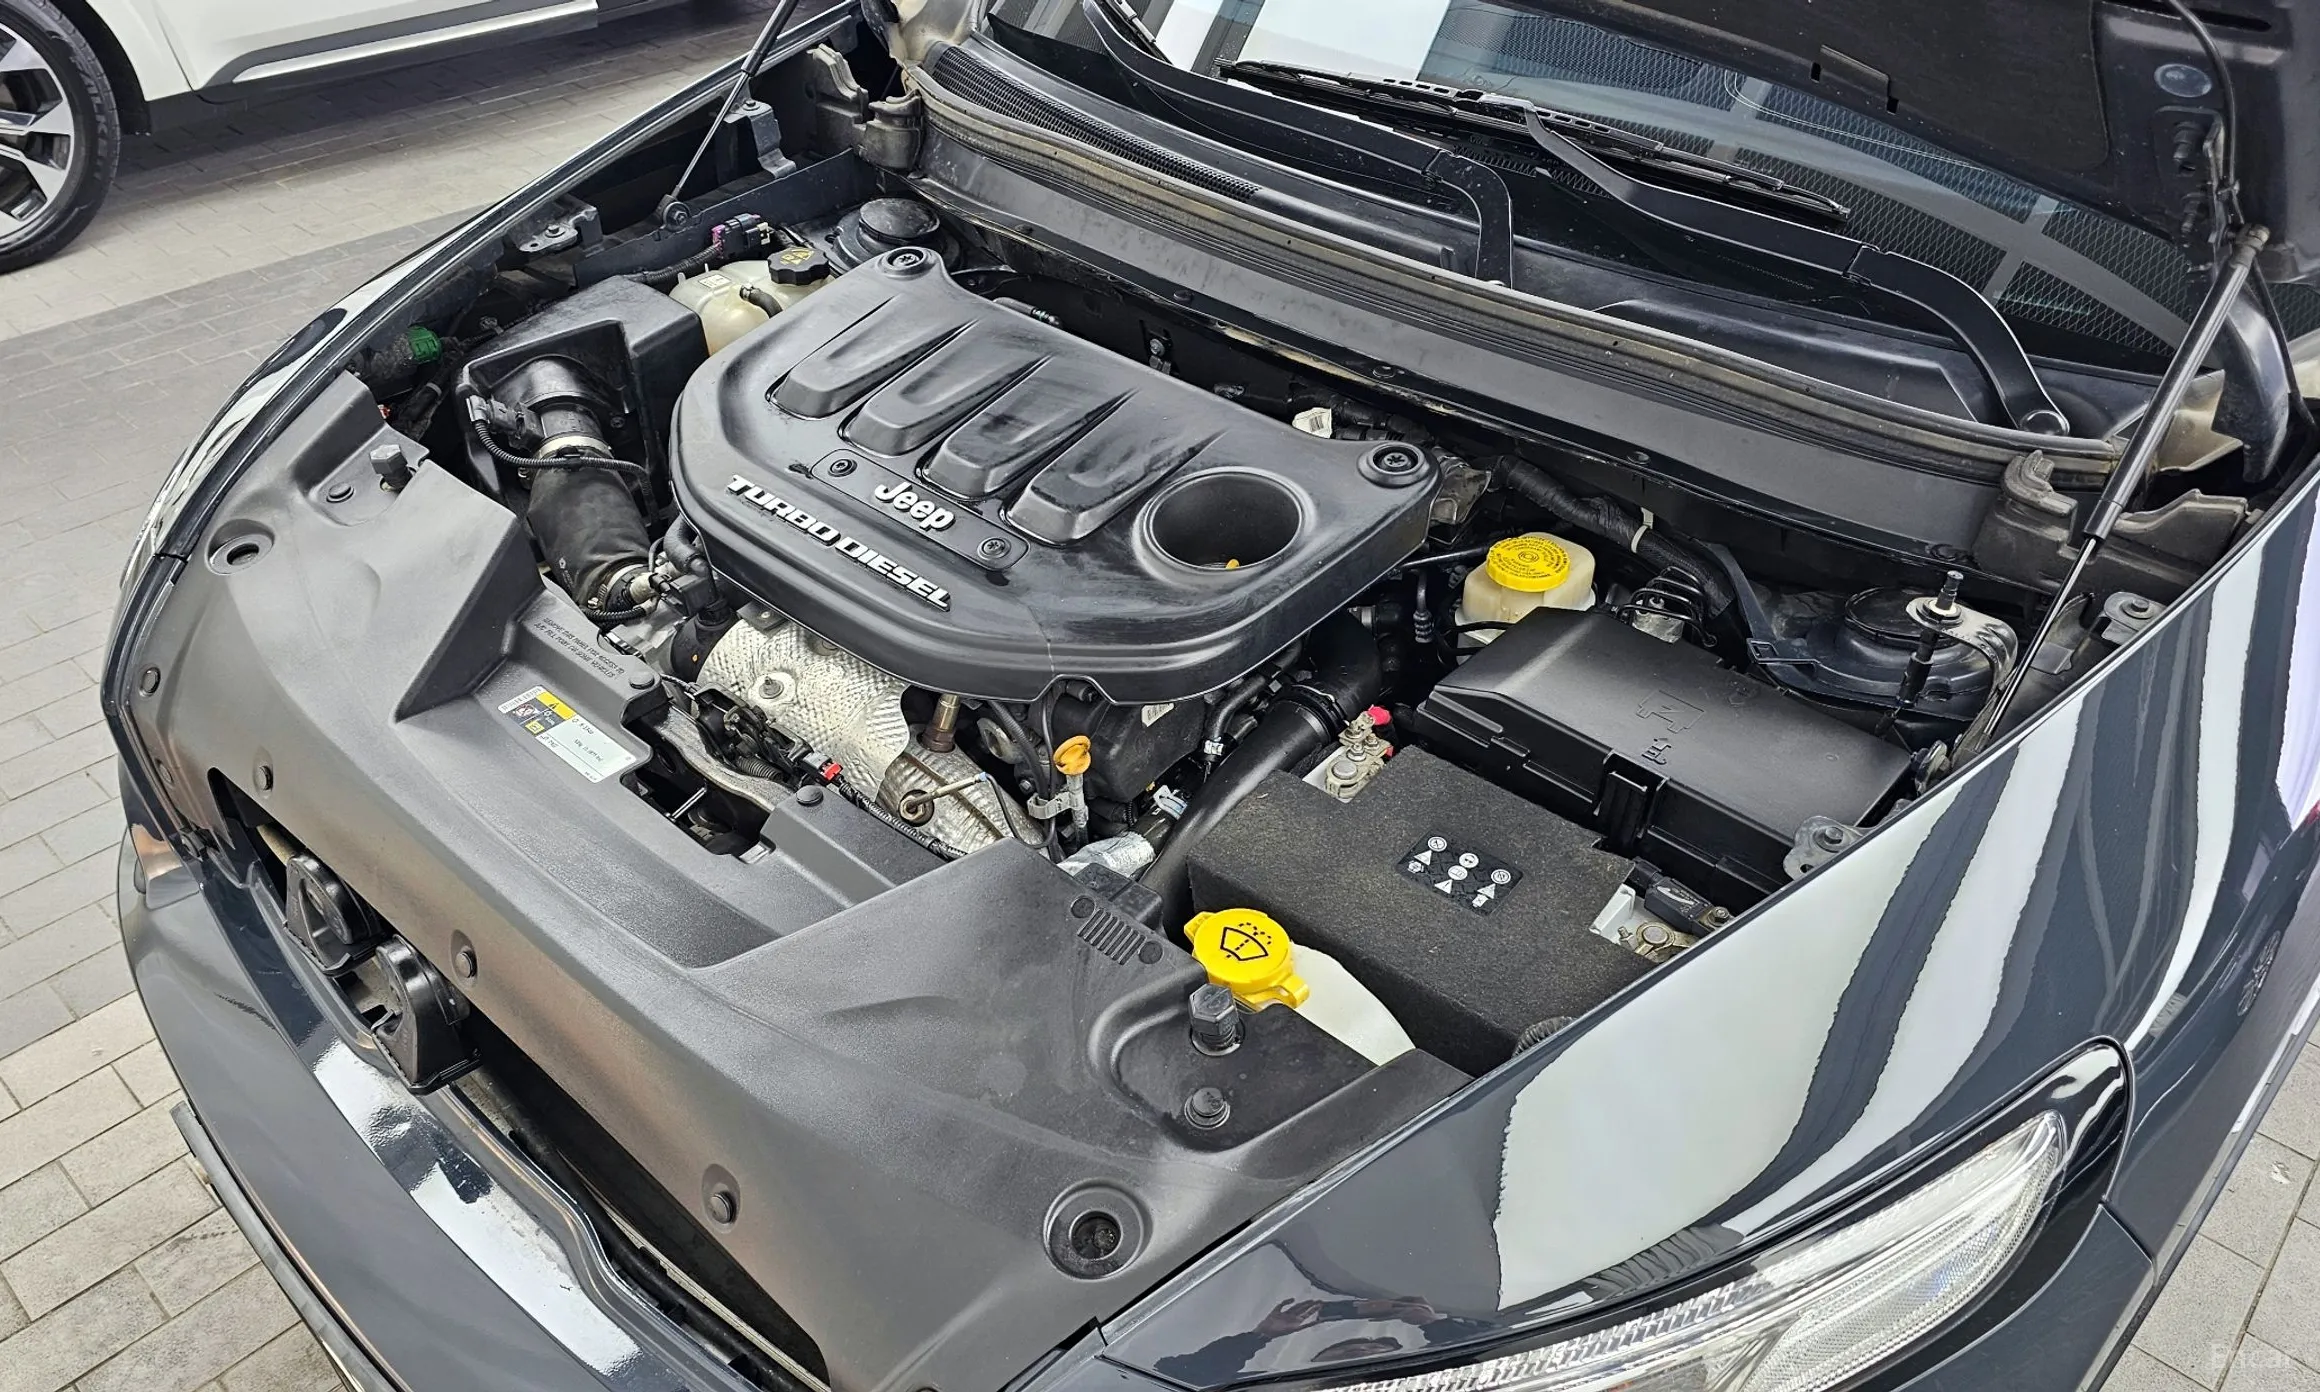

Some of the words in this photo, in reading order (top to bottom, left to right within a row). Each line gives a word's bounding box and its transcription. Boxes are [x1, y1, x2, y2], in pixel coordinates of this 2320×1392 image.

[726, 474, 840, 546] TURBO
[836, 536, 951, 611] DIESEL
[875, 481, 955, 532] Jeep
